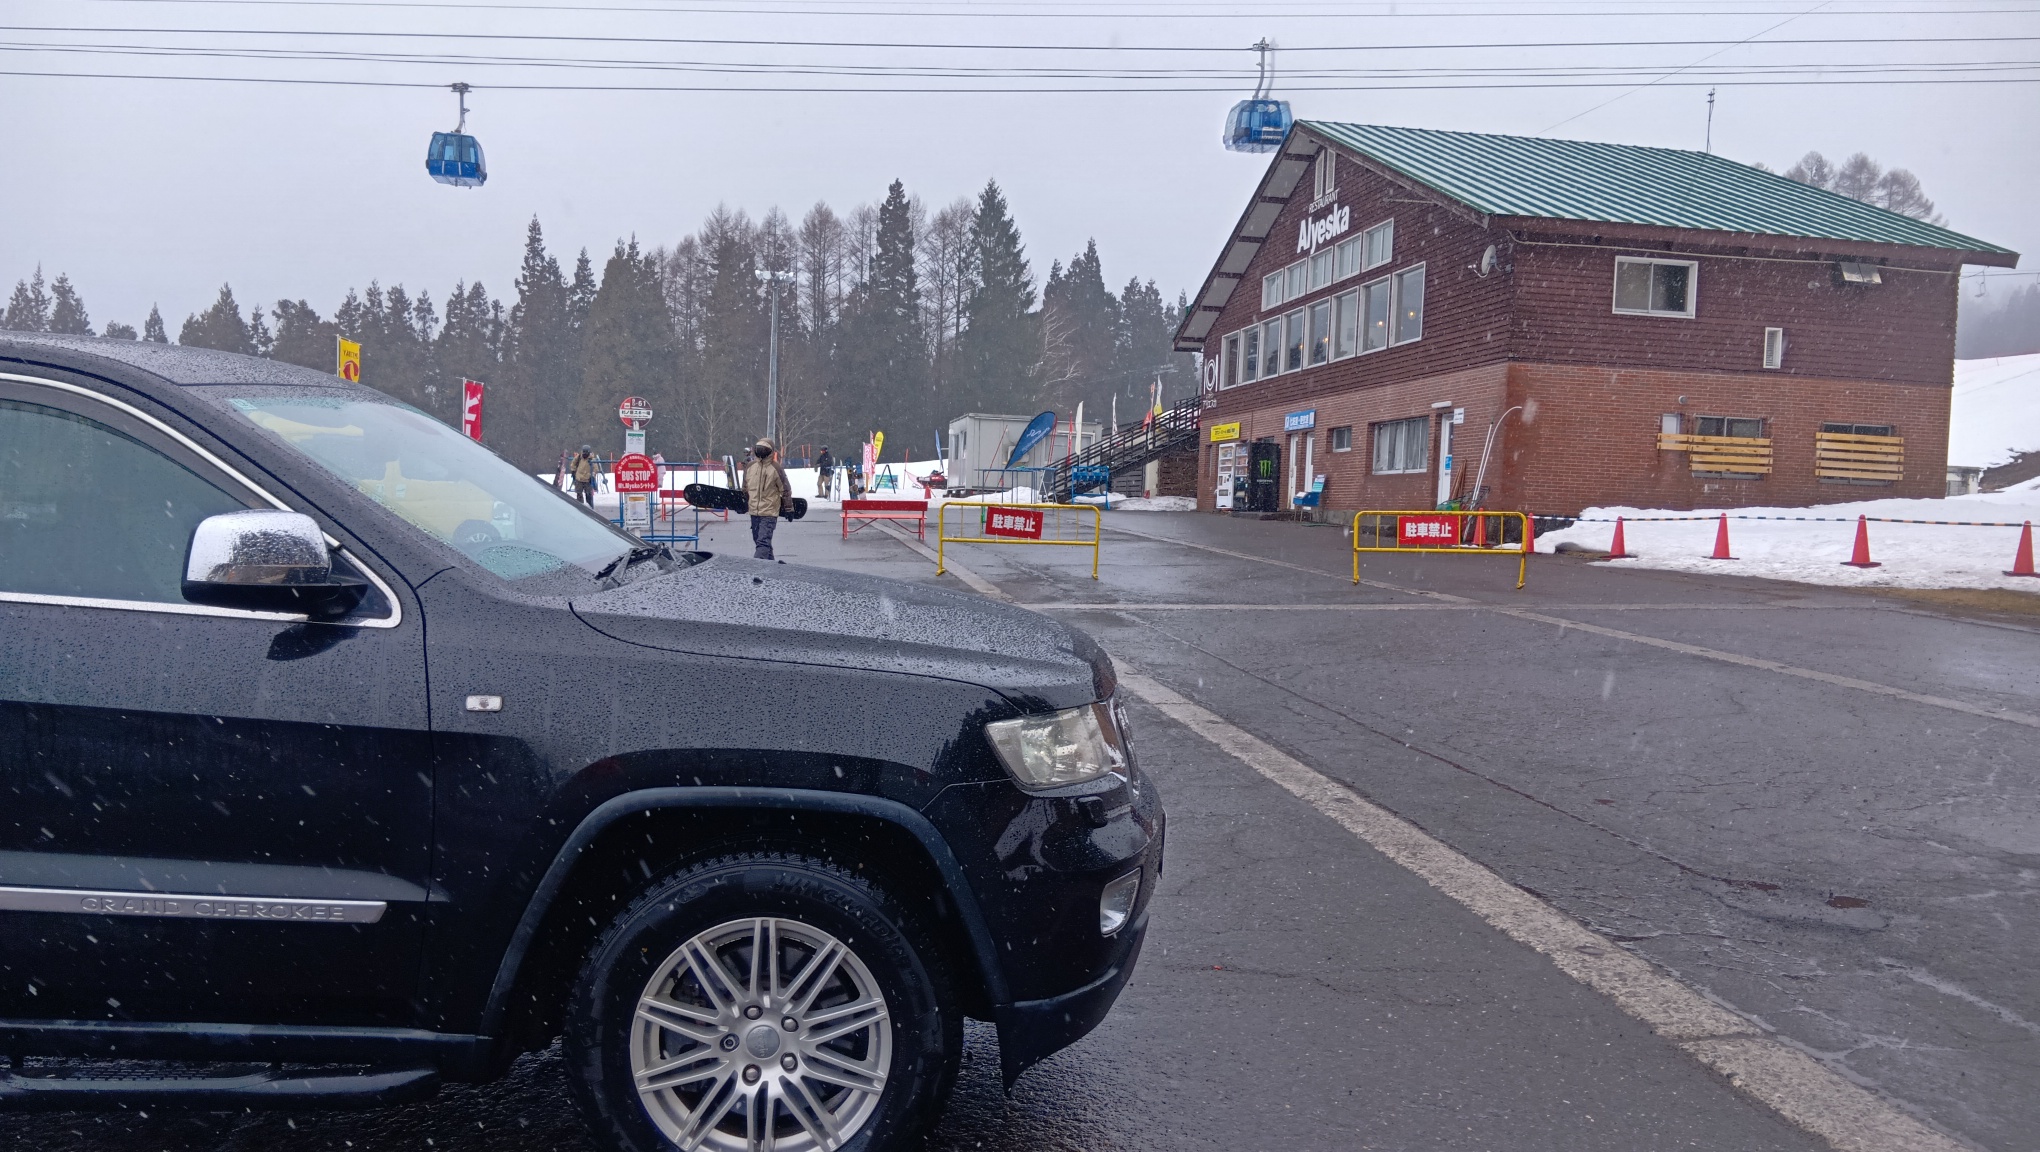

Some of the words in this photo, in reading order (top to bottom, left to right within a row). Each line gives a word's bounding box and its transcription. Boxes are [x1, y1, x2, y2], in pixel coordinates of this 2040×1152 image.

[1308, 188, 1340, 214] RESTAURANT
[1296, 203, 1350, 254] Alyeska
[621, 470, 635, 482] BUS
[635, 470, 651, 482] STOP
[992, 514, 1035, 532] 駐車禁止
[1405, 522, 1452, 538] 駐車禁止
[79, 897, 182, 915] GRAND
[193, 901, 346, 921] CHEROKEE
